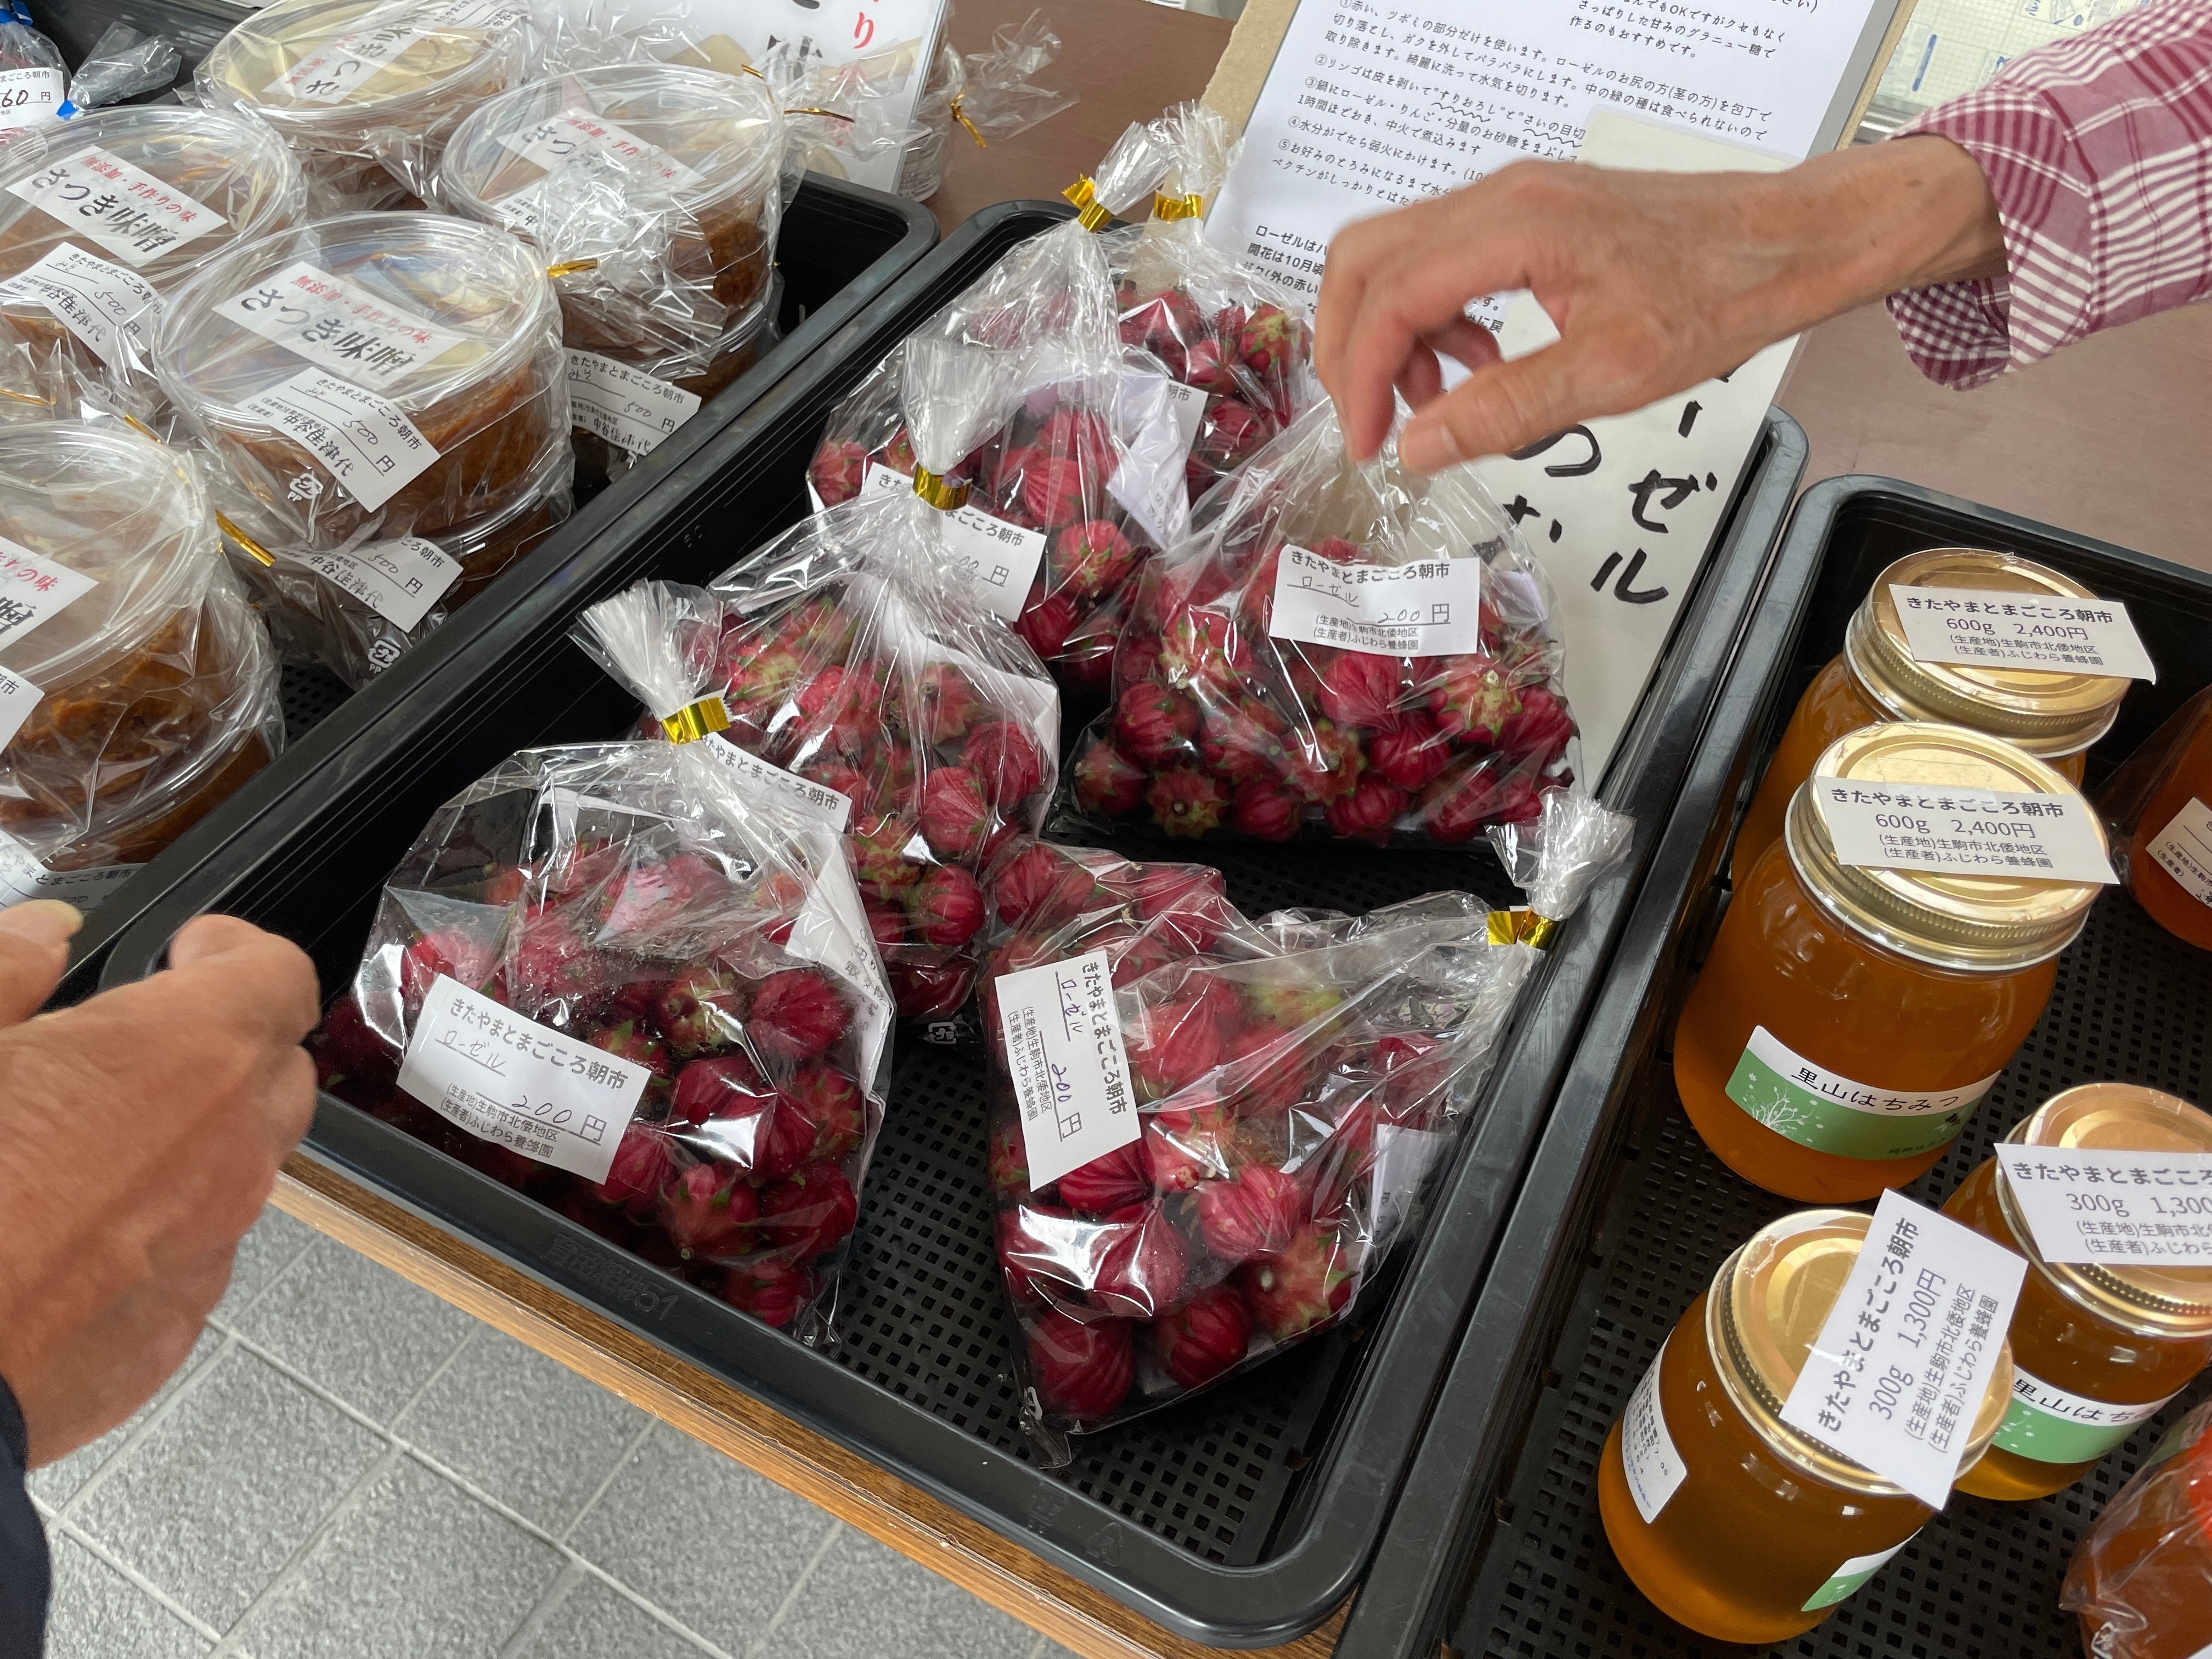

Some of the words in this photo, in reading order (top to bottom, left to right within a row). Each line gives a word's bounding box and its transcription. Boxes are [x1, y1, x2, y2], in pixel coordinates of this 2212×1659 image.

[1570, 15, 1696, 58] 作るのもおすすめです。
[41, 92, 50, 101] 円
[80, 155, 198, 223] 無添加・手作りの味
[32, 168, 179, 252] さつき味噌
[241, 289, 415, 375] さつき味噌
[571, 355, 685, 404] きたやまとまごころ朝市
[317, 379, 422, 450] きたやまとまごころ朝市
[624, 401, 652, 417] 500
[662, 417, 675, 433] 円
[343, 420, 379, 445] 500
[375, 455, 396, 473] 円
[990, 565, 1010, 585] 円
[1291, 550, 1450, 585] きたやまとまごころ朝市
[405, 577, 423, 595] 円
[1378, 609, 1420, 624] 200
[1431, 603, 1451, 625] 円
[1907, 597, 2113, 624] きたやまとまごころ朝市
[1946, 618, 1995, 635] 600g
[2016, 623, 2089, 640] 2,400円
[1950, 635, 2099, 654] (生産地)生駒市北倭地区
[1831, 788, 2064, 817] きたやまとまごころ朝市
[1876, 814, 1931, 834] 600g
[1951, 819, 2035, 838] 2,400円
[1880, 834, 2047, 855] (生産地)生駒市北倭地区
[2157, 850, 2184, 877] (生産者)
[449, 998, 628, 1091] きたやまとまごころ朝市
[1082, 962, 1128, 1116] きたやまとまごころ朝市
[1052, 1063, 1071, 1103] 200
[1791, 1067, 1959, 1110] 里山はちみつ
[512, 1094, 572, 1124] 200
[580, 1113, 607, 1142] 円
[1060, 1112, 1082, 1138] 円
[2066, 1193, 2130, 1217] 300g
[1817, 1217, 1920, 1432] きたやまとまごころ朝市
[1869, 1364, 1914, 1420] 300g
[1898, 1268, 1946, 1348] 1,300円
